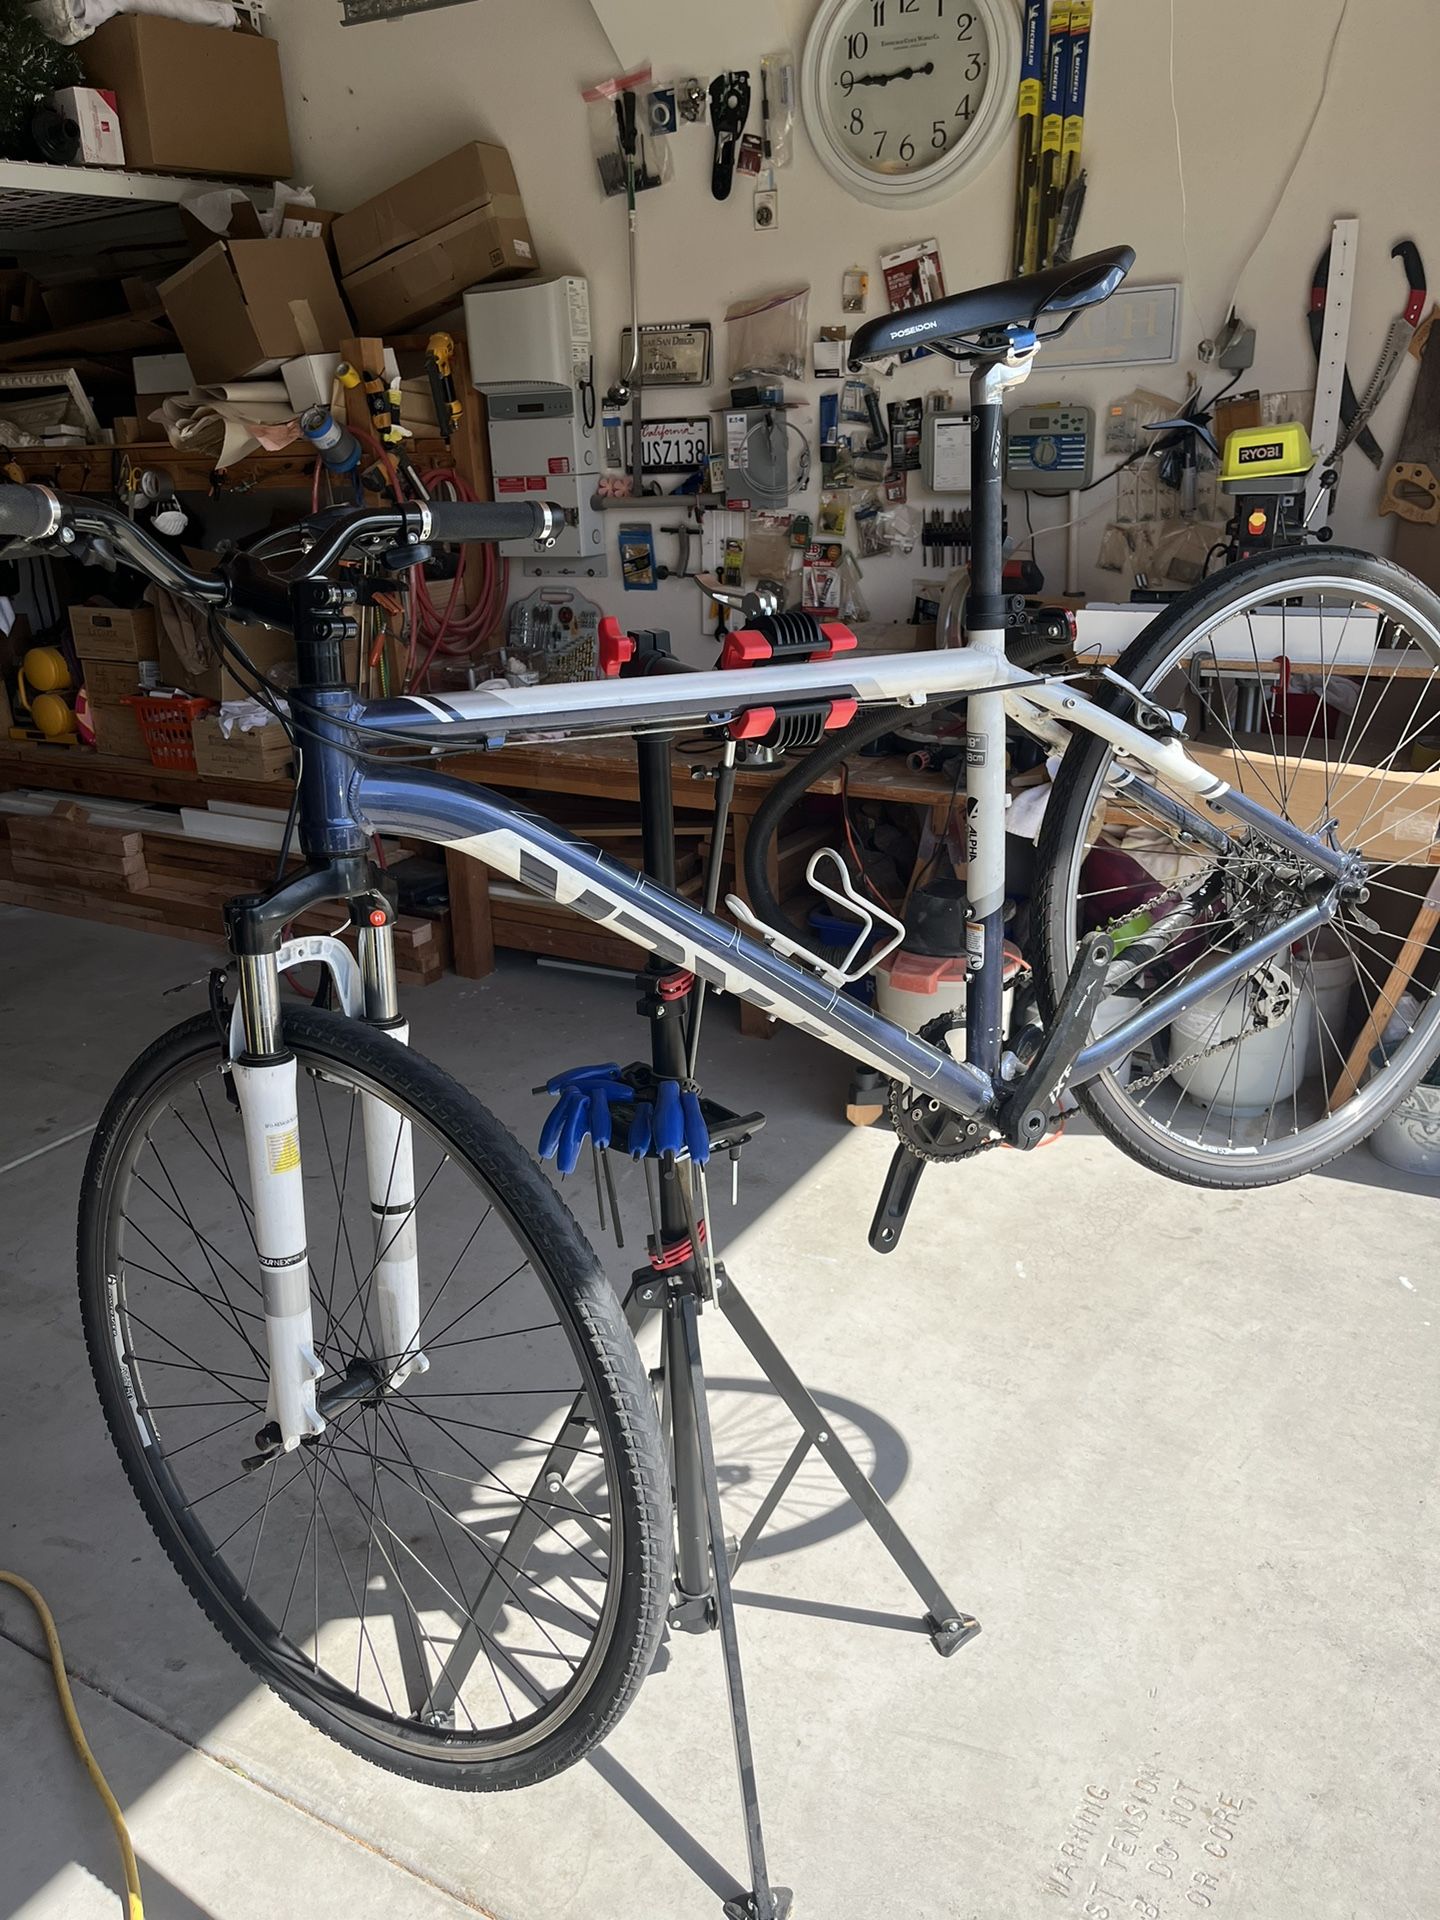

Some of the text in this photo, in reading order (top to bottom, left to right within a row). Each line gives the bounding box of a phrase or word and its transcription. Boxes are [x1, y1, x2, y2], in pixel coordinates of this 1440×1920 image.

[873, 0, 885, 27] 11
[957, 13, 973, 41] 2
[848, 32, 868, 59] 10
[1028, 20, 1036, 66] MICHELIN
[965, 53, 981, 81] 3
[1051, 56, 1060, 102] MICHELIN
[1072, 57, 1081, 103] MICHELIN
[840, 70, 854, 97] 9
[955, 94, 970, 120] 4
[850, 108, 864, 135] 8
[931, 120, 947, 148] 5
[873, 131, 887, 157] 7
[900, 134, 915, 161] 6
[890, 320, 938, 340] POSEIDON
[644, 361, 677, 371] JAGUAR
[641, 424, 695, 439] California
[639, 439, 705, 465] USZ138
[1240, 446, 1281, 461] RYOBI
[967, 752, 984, 763] 8cm
[968, 825, 978, 862] ALPHA
[1042, 1783, 1110, 1899] WARNING
[1146, 1839, 1180, 1880] DO
[1163, 1778, 1201, 1829] NOT
[1185, 1790, 1244, 1909] OR CORE
